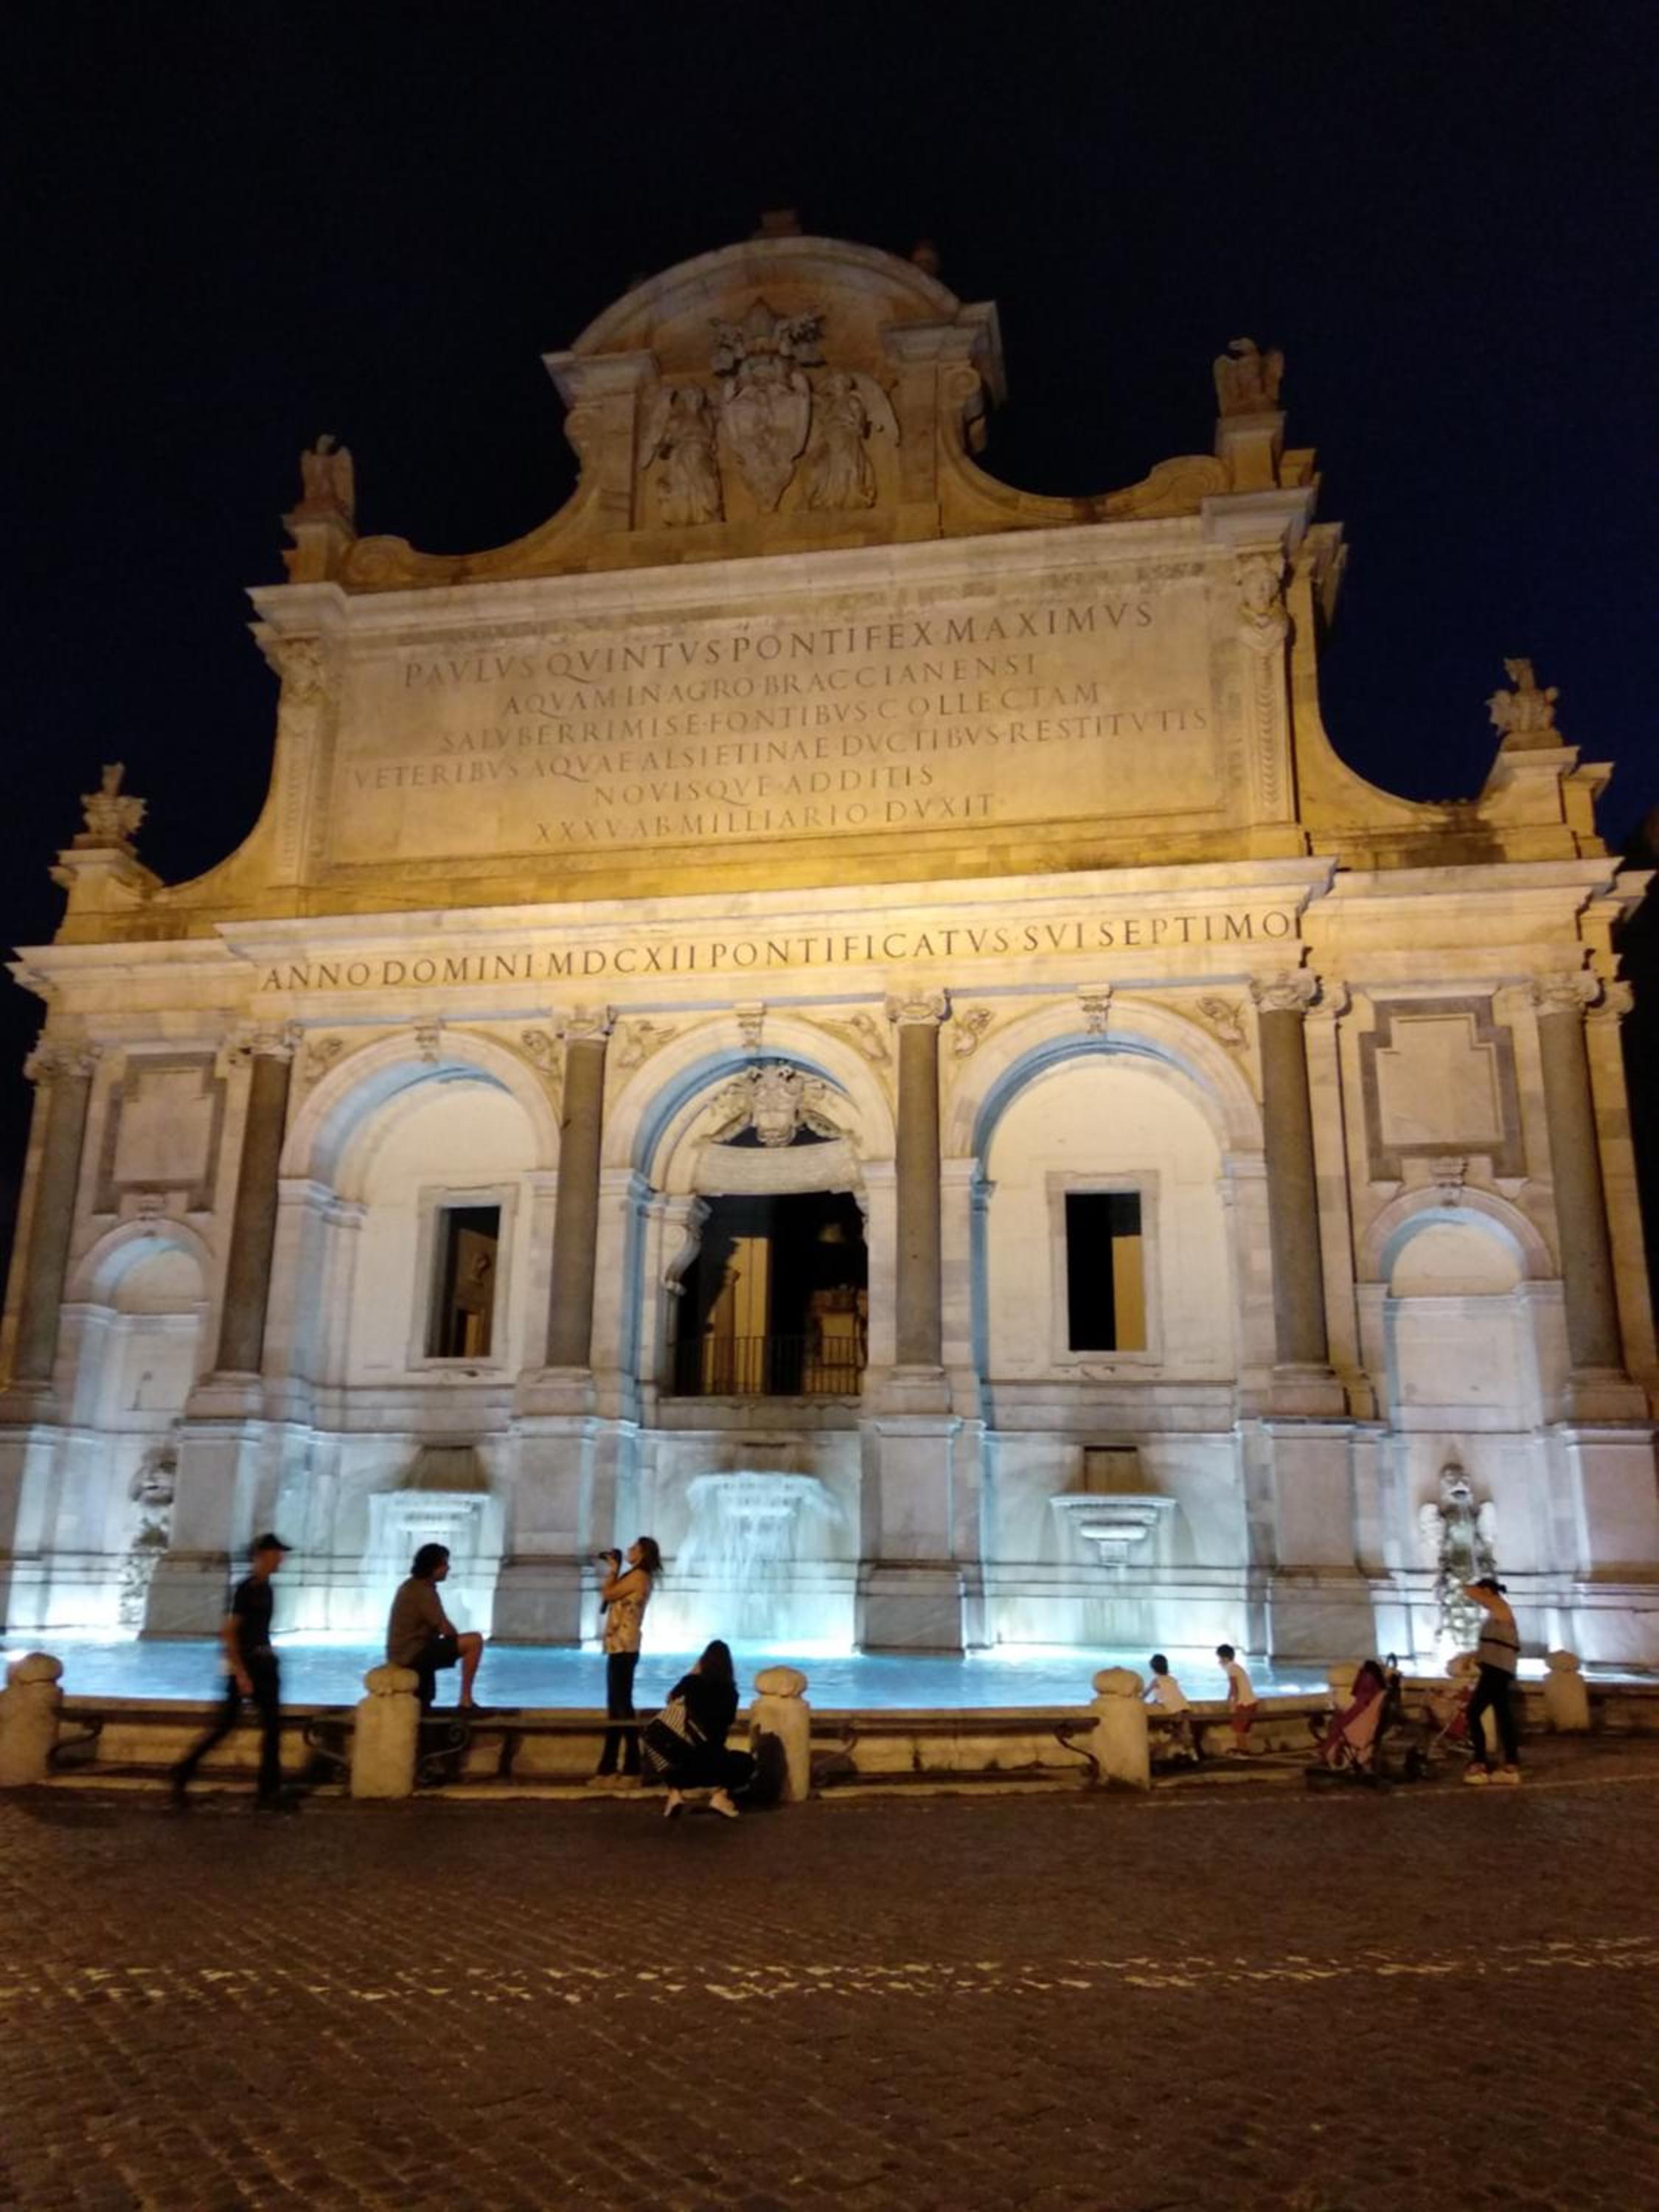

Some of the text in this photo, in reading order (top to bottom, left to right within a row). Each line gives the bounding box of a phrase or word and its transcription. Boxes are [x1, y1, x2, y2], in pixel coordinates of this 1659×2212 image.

[405, 602, 1153, 687] PAVLVS QVINTVS PONTIFEX MAXIMVS
[764, 653, 1034, 697] BRACCIANENSI
[709, 700, 868, 733] FONTIBVS
[877, 682, 1099, 719] COLLECTAM
[353, 759, 519, 790] VETERIBVS
[842, 726, 1000, 757] DVCTIBVS
[1009, 707, 1208, 744] RESTITVTIS
[784, 765, 933, 795] ADDITIS
[886, 793, 993, 822] DVXIT
[262, 911, 1289, 990] ANNO DOMINI MDCXII PONTIFICATVS SVI SEPTIMO
